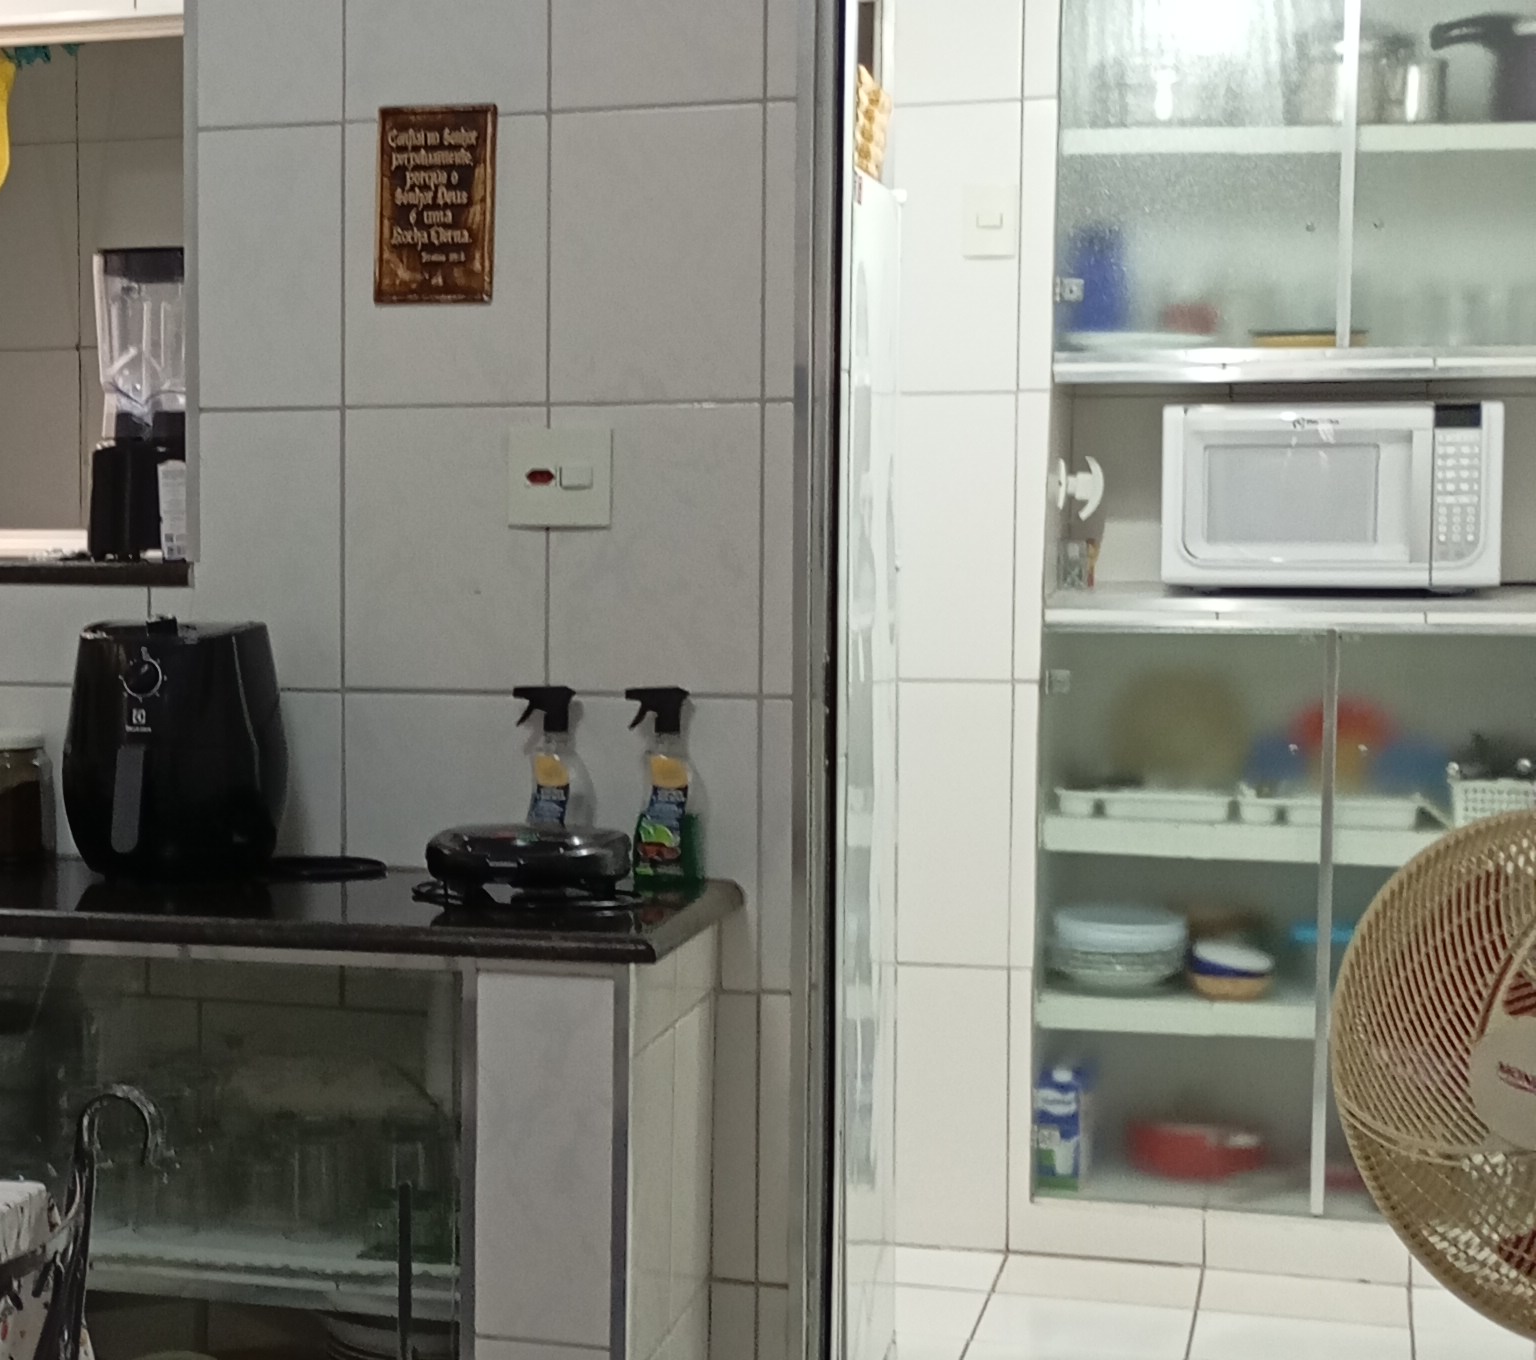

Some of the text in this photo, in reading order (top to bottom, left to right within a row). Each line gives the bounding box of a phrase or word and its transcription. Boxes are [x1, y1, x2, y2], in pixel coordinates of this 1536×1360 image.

[406, 169, 459, 191] porque o
[394, 185, 468, 210] Senhor Deus
[423, 208, 453, 225] uma
[391, 226, 429, 251] Rocha
